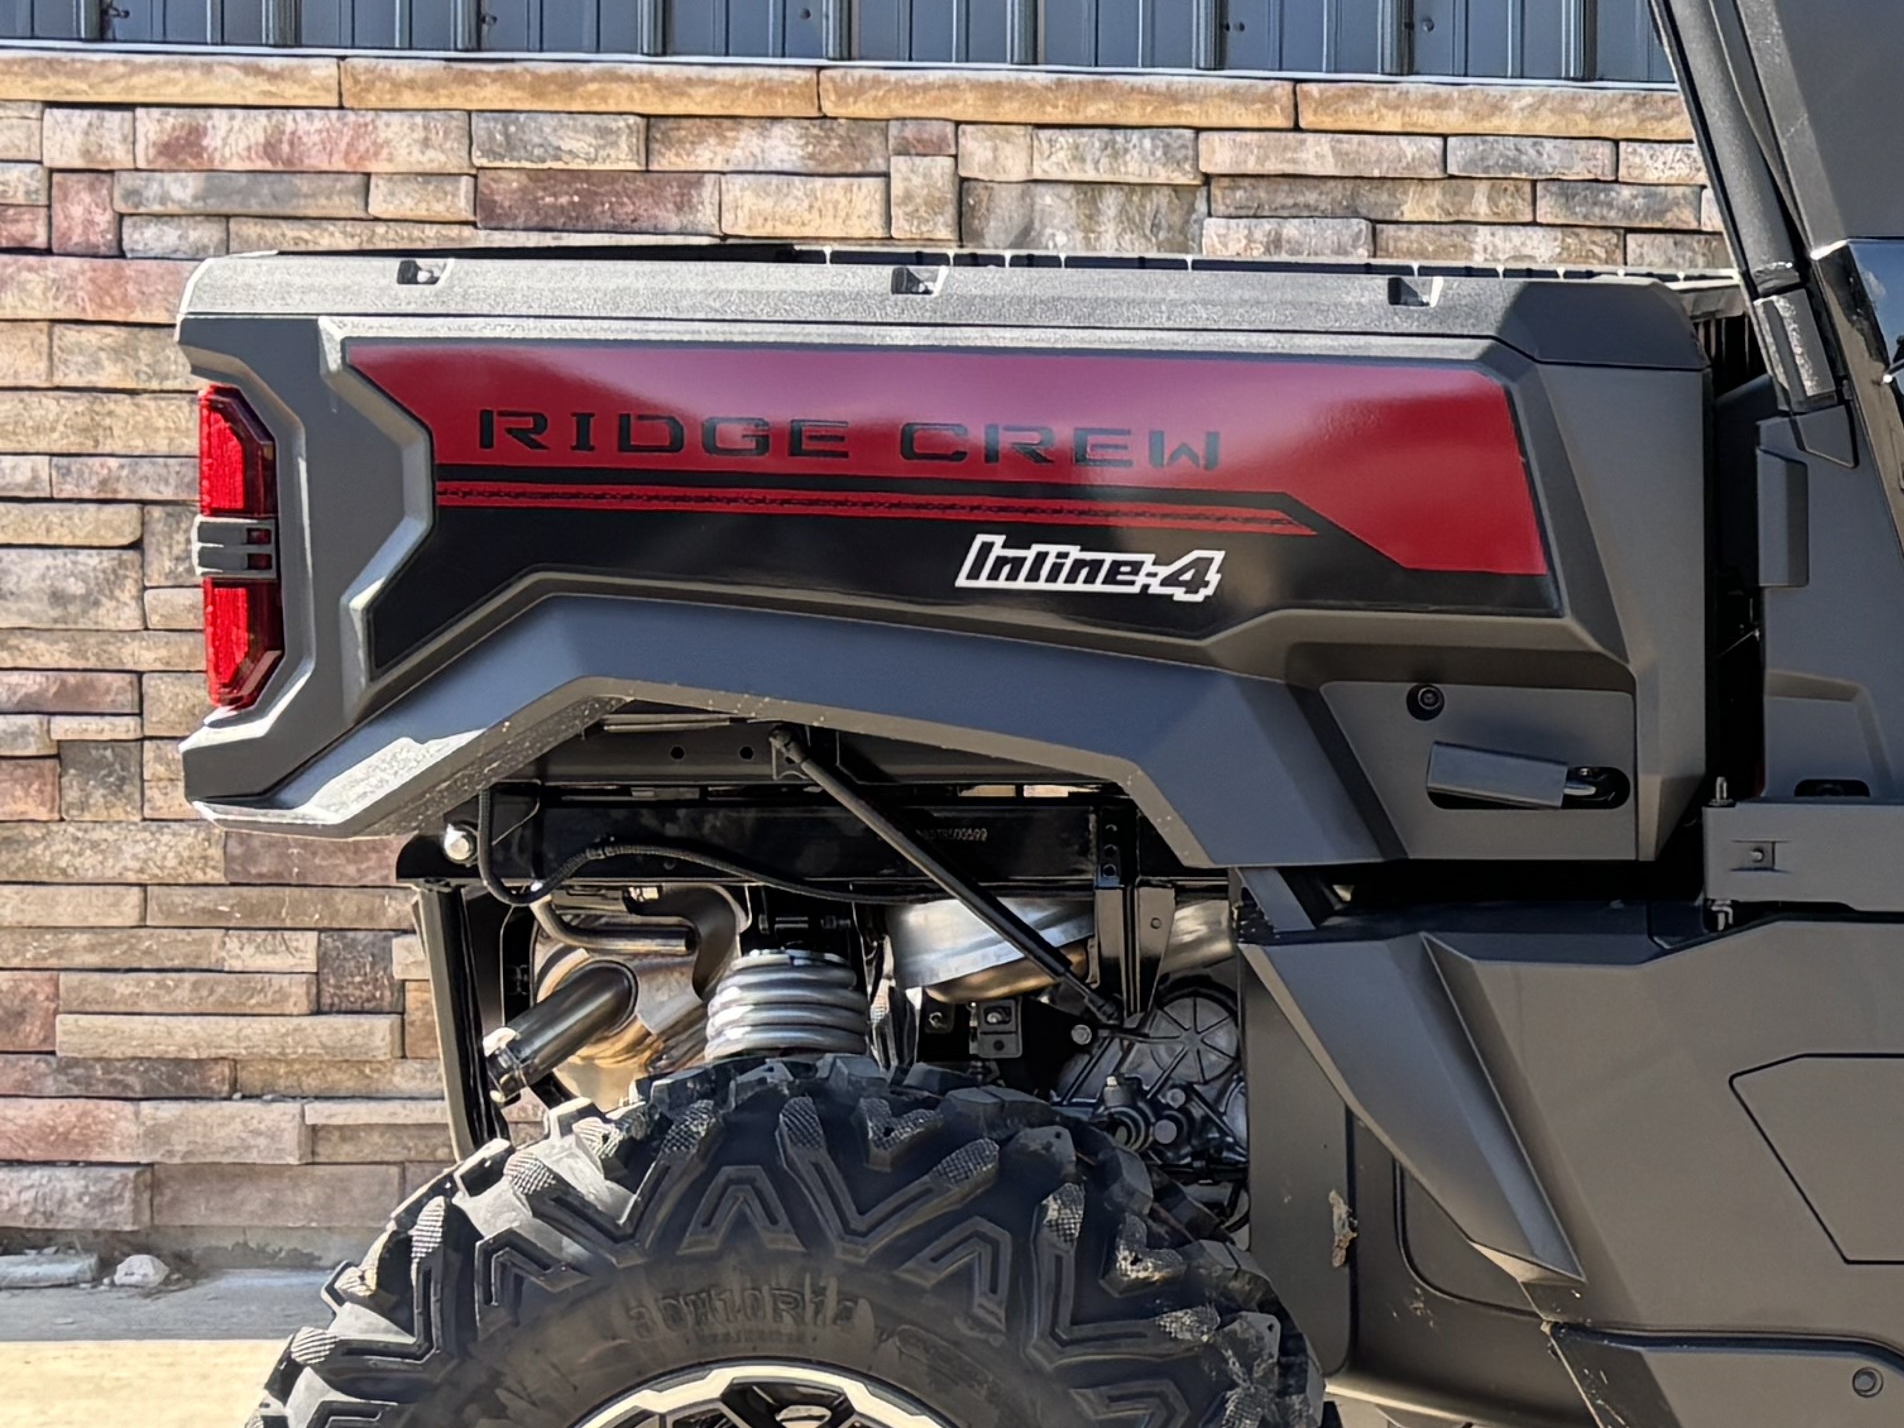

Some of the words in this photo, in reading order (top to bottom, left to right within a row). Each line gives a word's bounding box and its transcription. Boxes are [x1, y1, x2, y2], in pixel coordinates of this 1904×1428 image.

[478, 408, 850, 460] RIDGE
[899, 422, 1221, 471] CREW
[961, 536, 1222, 599] Inline-4
